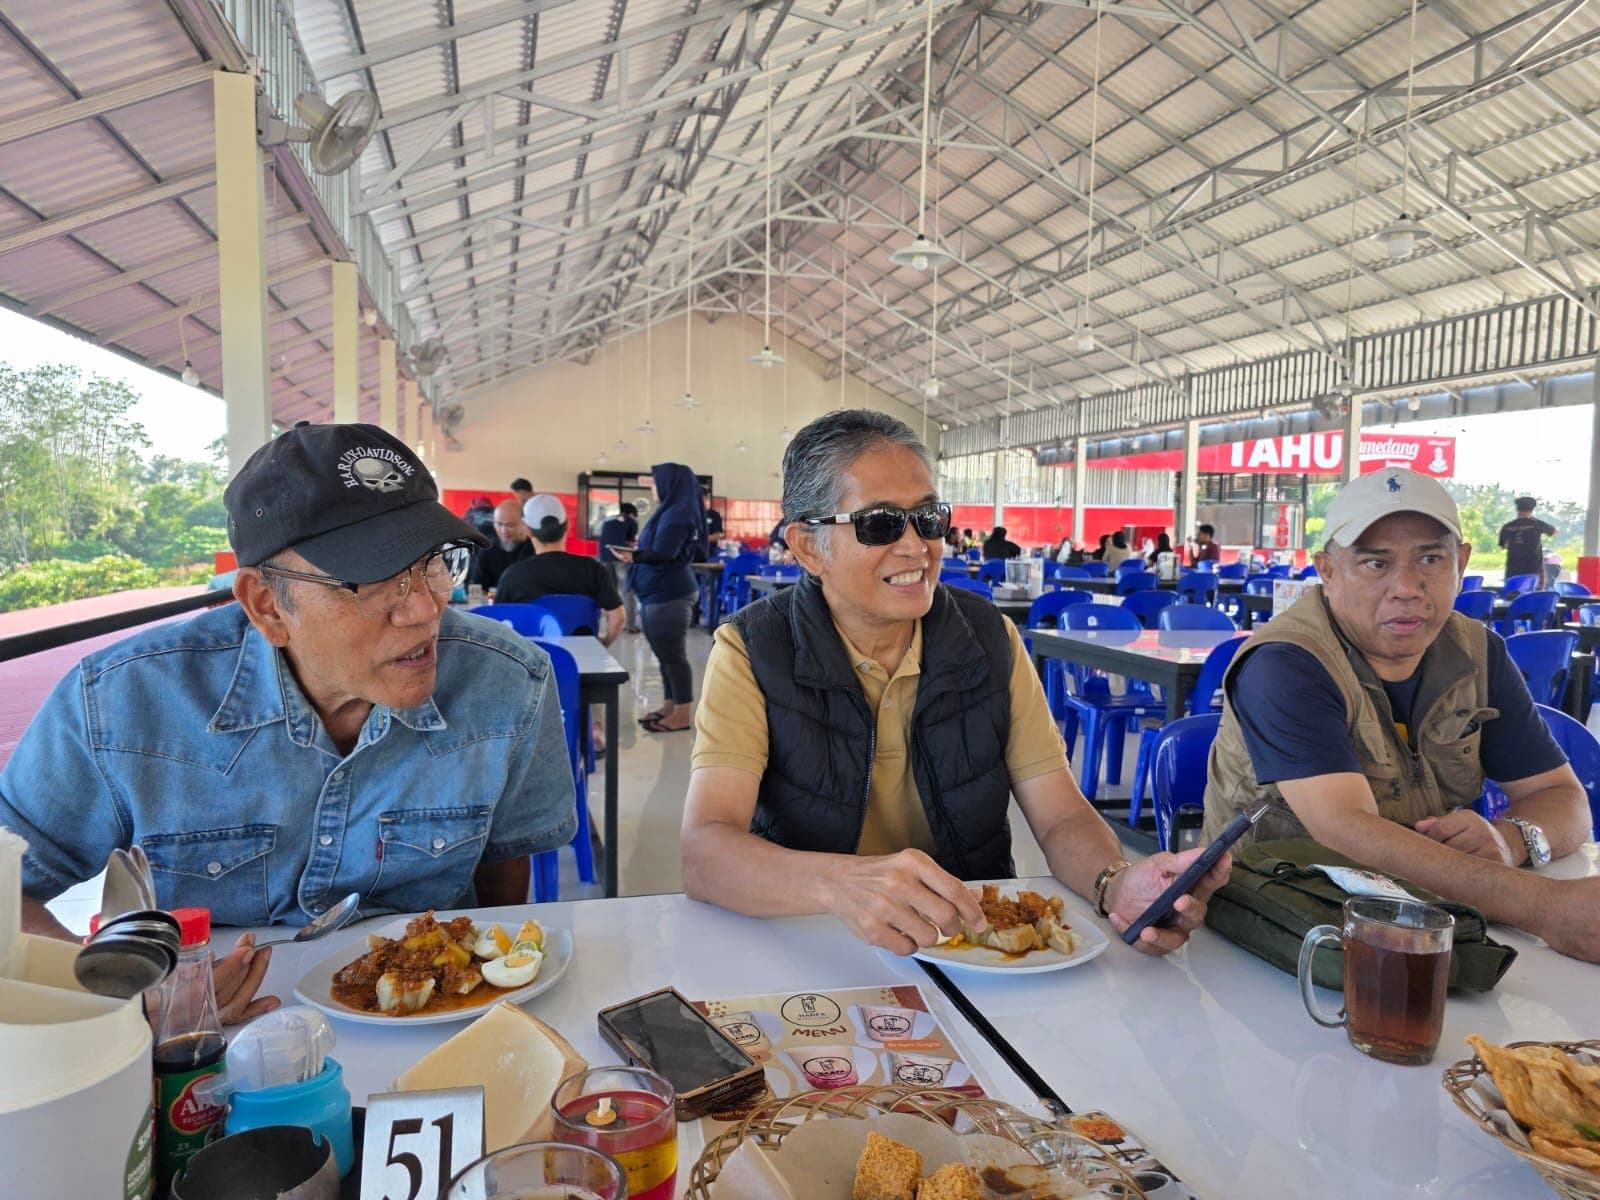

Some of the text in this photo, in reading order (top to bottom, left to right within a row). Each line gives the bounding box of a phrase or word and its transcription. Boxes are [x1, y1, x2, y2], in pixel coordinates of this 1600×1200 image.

[1360, 438, 1419, 460] umedang
[792, 1025, 847, 1038] MENU
[386, 1112, 454, 1200] 51
